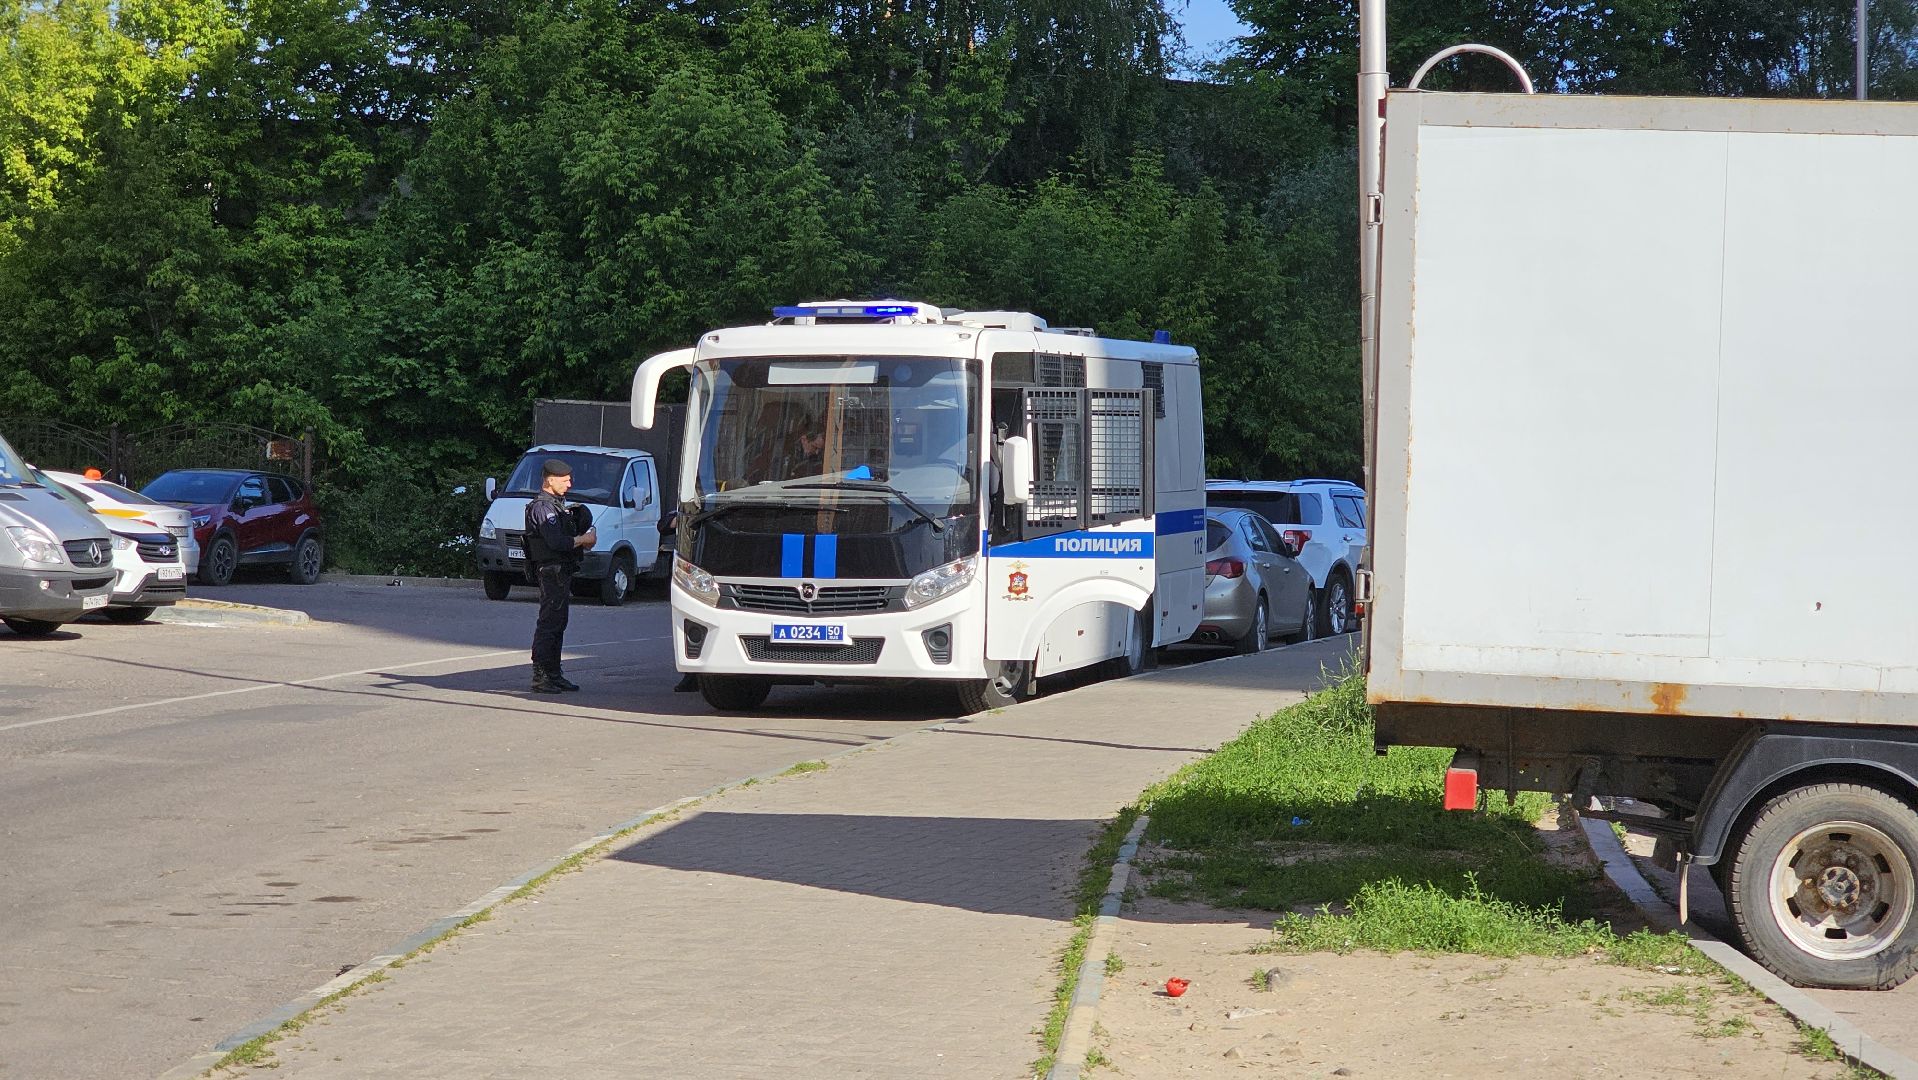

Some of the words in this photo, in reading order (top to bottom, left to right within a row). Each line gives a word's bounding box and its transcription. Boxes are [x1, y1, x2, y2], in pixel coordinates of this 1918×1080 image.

[1055, 538, 1142, 554] ПОЛИЦИЯ
[790, 626, 820, 639] 0234
[828, 626, 840, 636] 50
